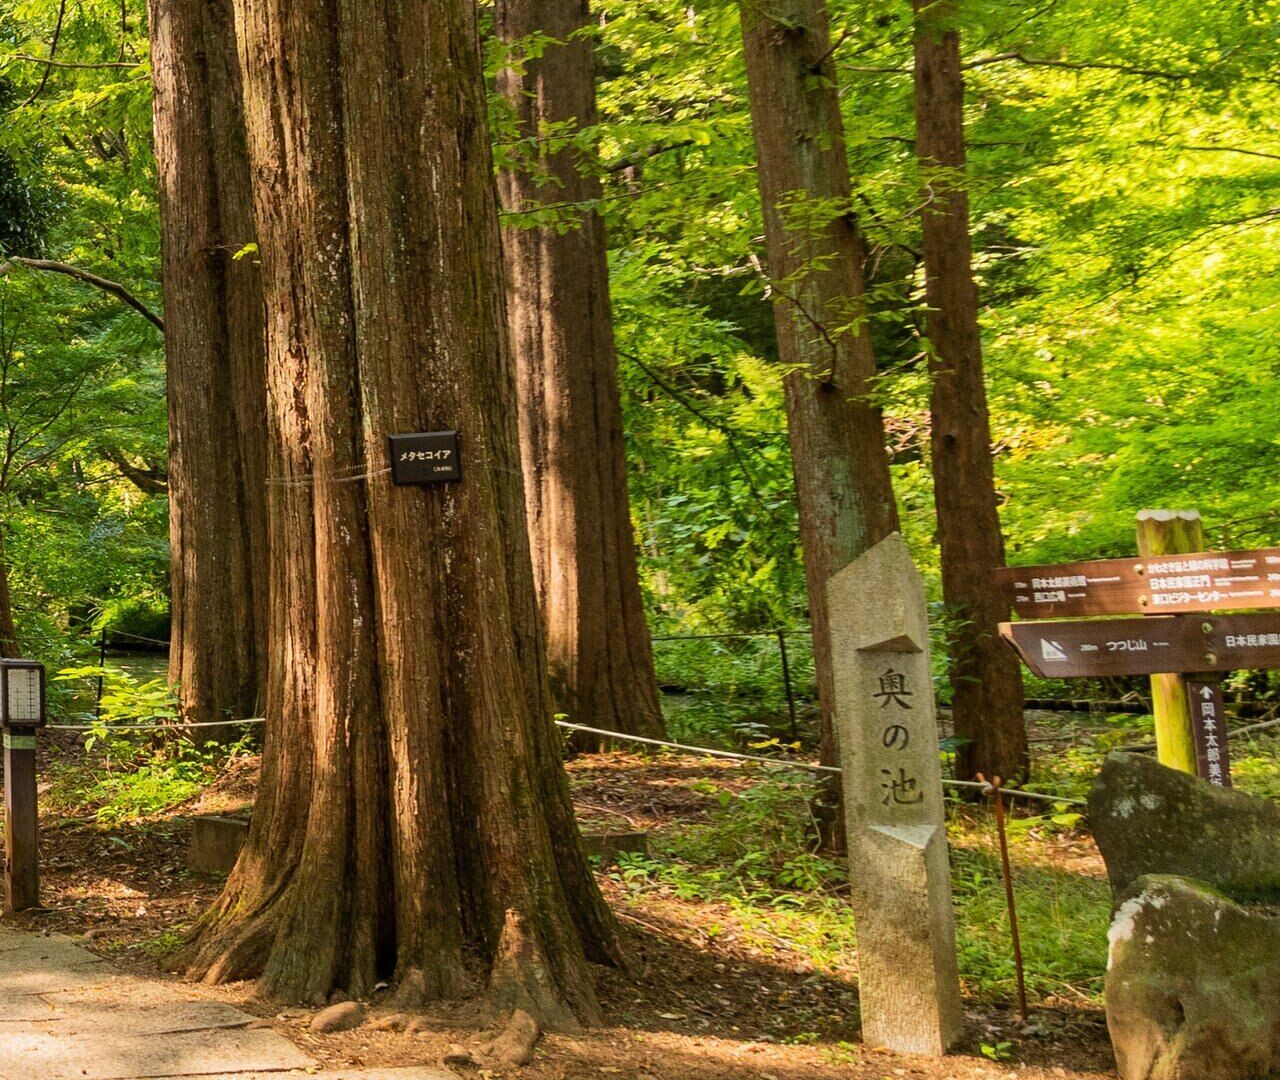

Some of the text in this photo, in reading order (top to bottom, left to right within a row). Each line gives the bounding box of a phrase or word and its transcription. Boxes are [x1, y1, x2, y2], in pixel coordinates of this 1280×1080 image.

[400, 449, 451, 461] メタセコイア
[1106, 639, 1147, 651] つつじ山
[1225, 633, 1280, 648] 日本民家園
[873, 668, 924, 806] 奥の池
